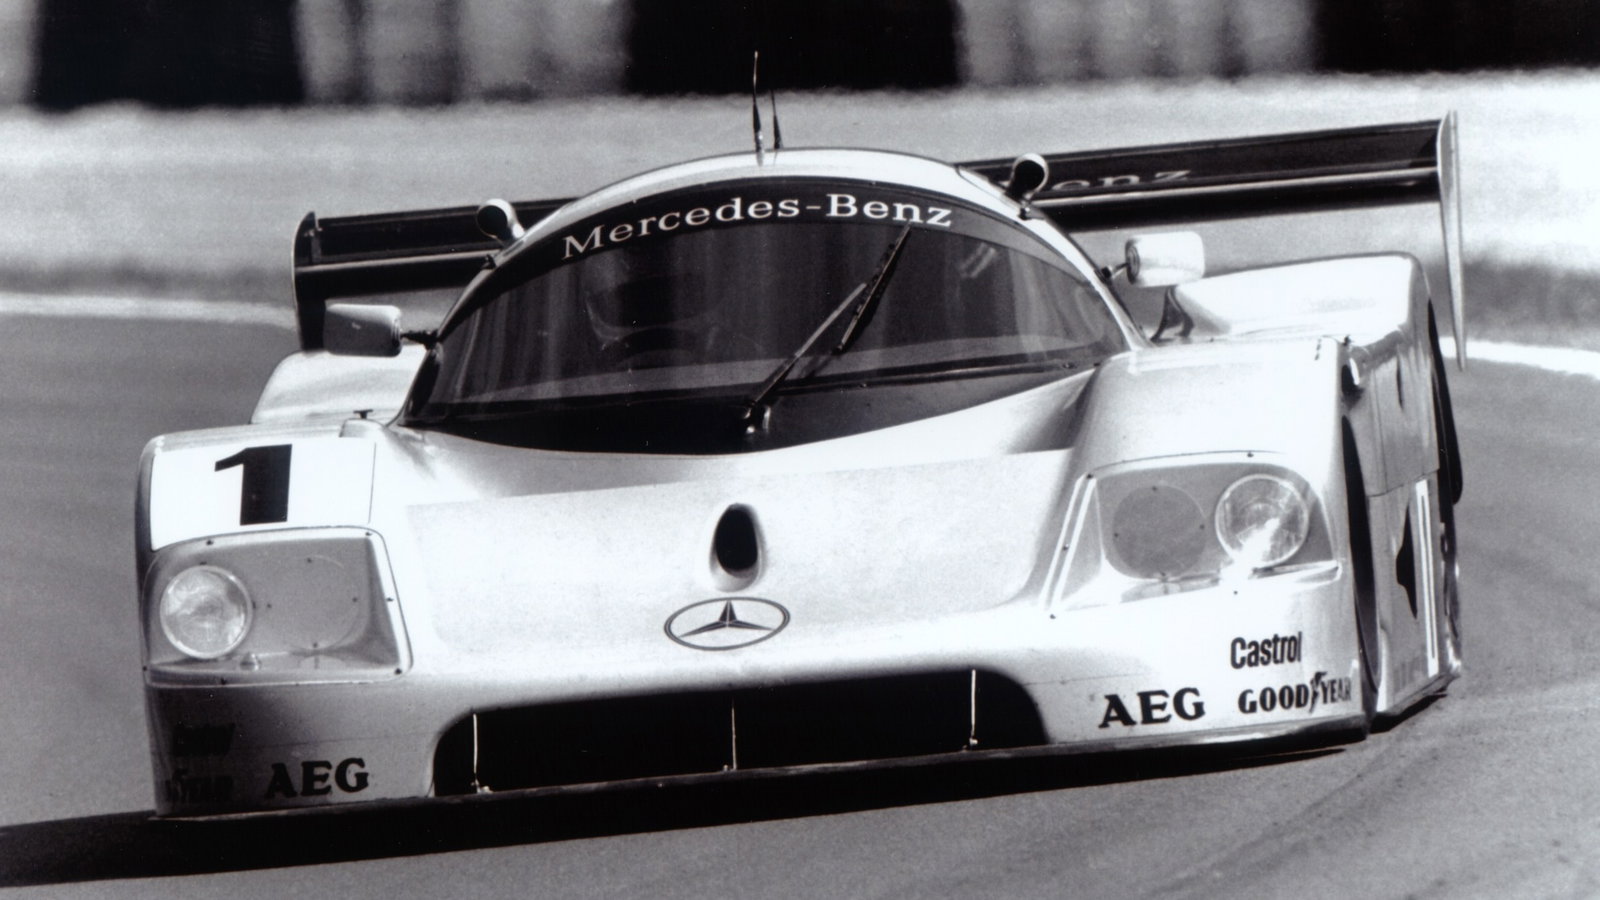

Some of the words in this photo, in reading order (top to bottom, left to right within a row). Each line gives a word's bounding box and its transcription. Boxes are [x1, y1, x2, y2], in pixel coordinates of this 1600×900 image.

[1039, 168, 1191, 187] enz
[562, 192, 953, 260] Mercedes-Benz
[214, 443, 293, 526] 1
[1230, 631, 1303, 670] Castrol
[1099, 687, 1206, 728] AEG
[1238, 671, 1351, 714] GOODYEAR
[265, 757, 370, 799] AEG
